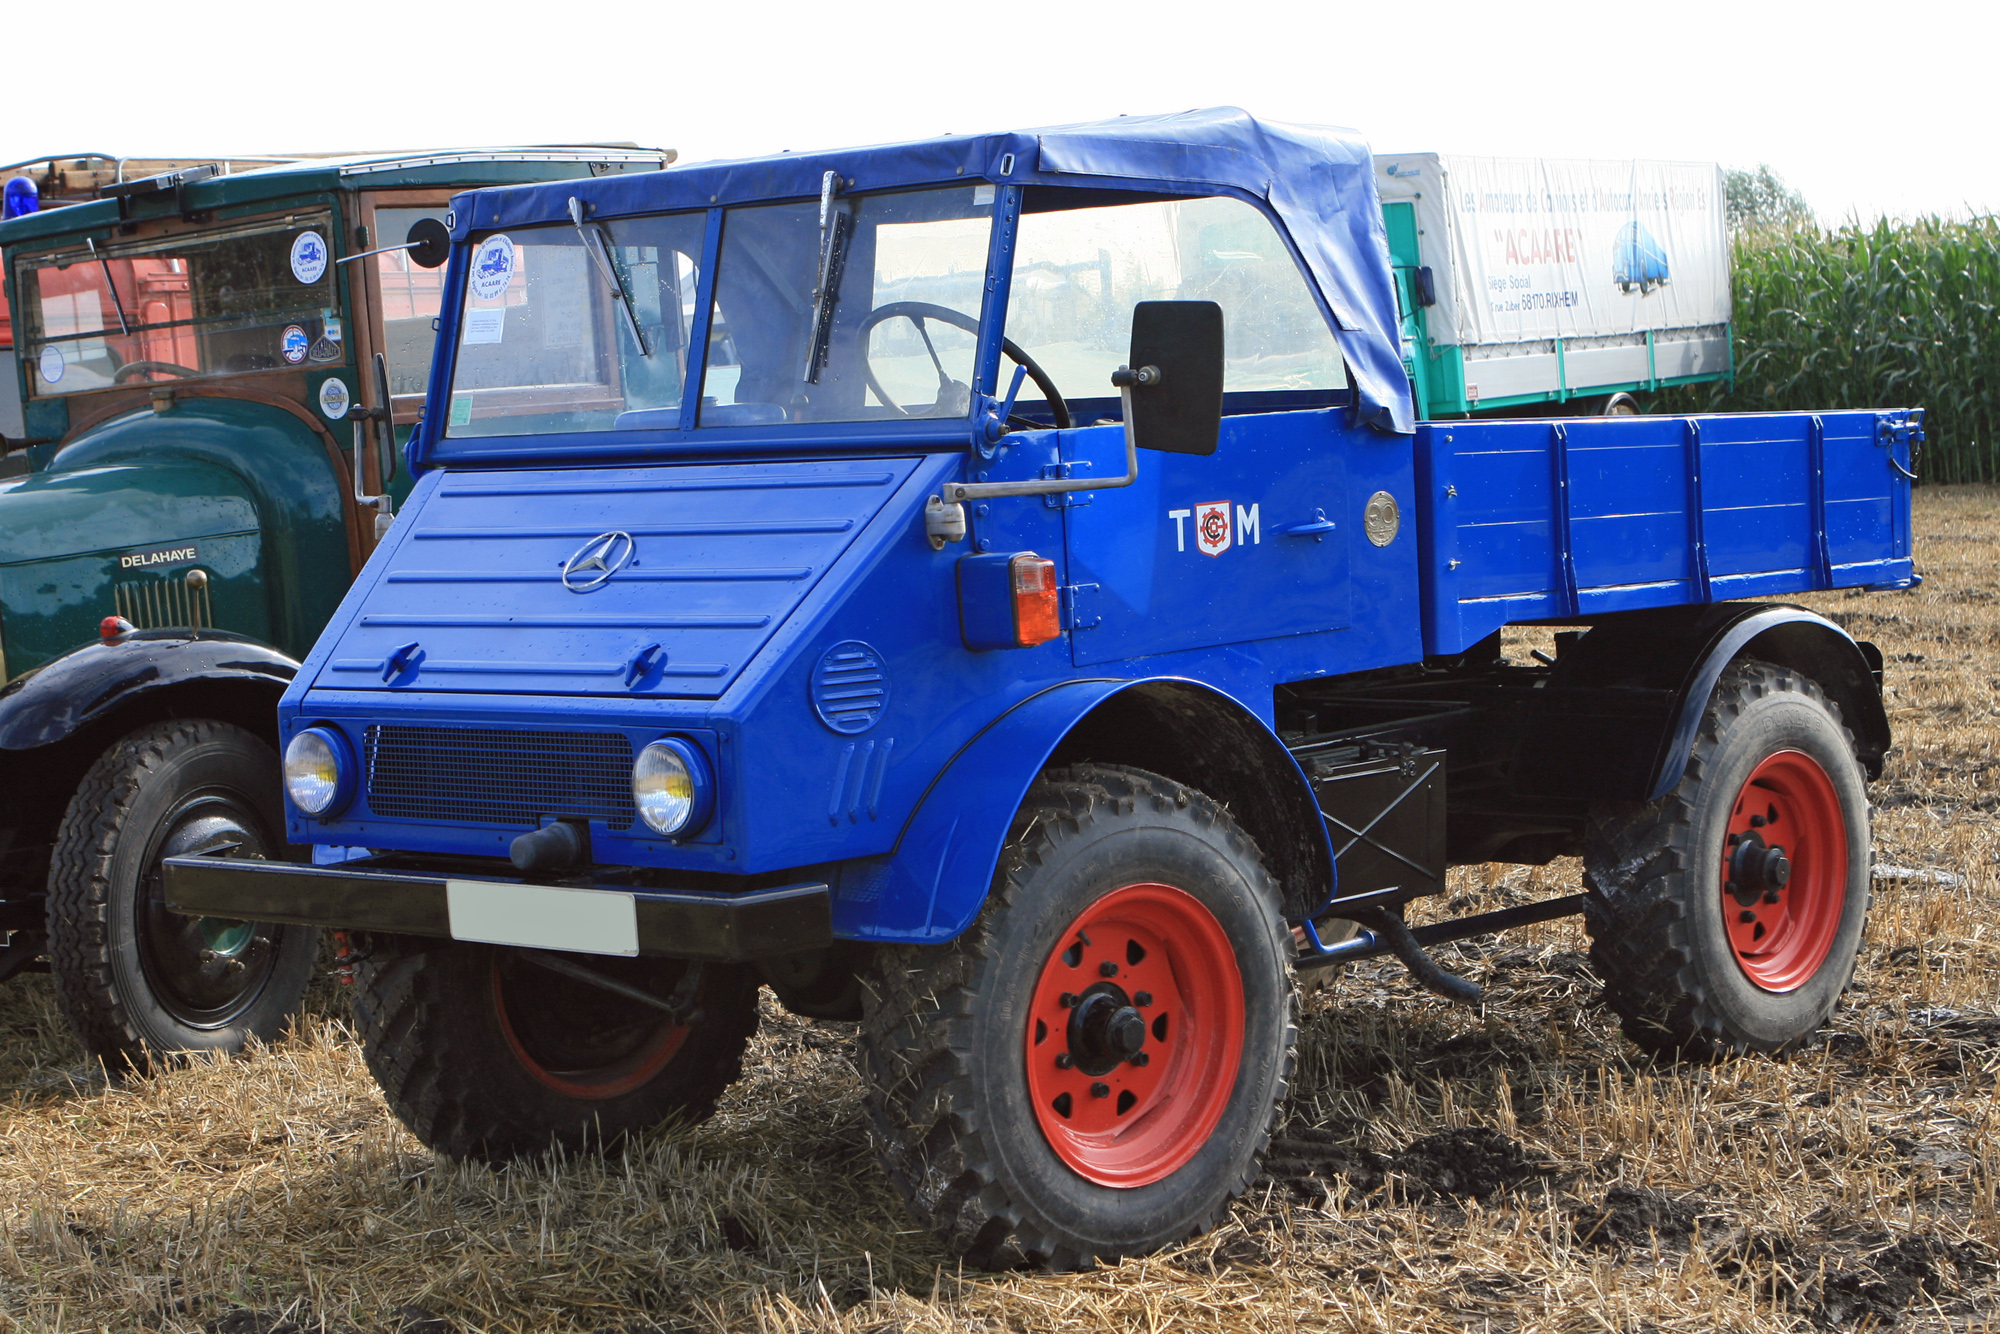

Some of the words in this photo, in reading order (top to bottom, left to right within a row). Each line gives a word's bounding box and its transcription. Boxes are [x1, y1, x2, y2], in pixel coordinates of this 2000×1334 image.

[1459, 185, 1476, 213] Les
[1480, 187, 1523, 213] Amateurs
[1526, 185, 1538, 213] de
[1638, 186, 1668, 212] Ancies
[120, 547, 197, 568] DELAHAYE
[1761, 708, 1824, 734] DUNLOP
